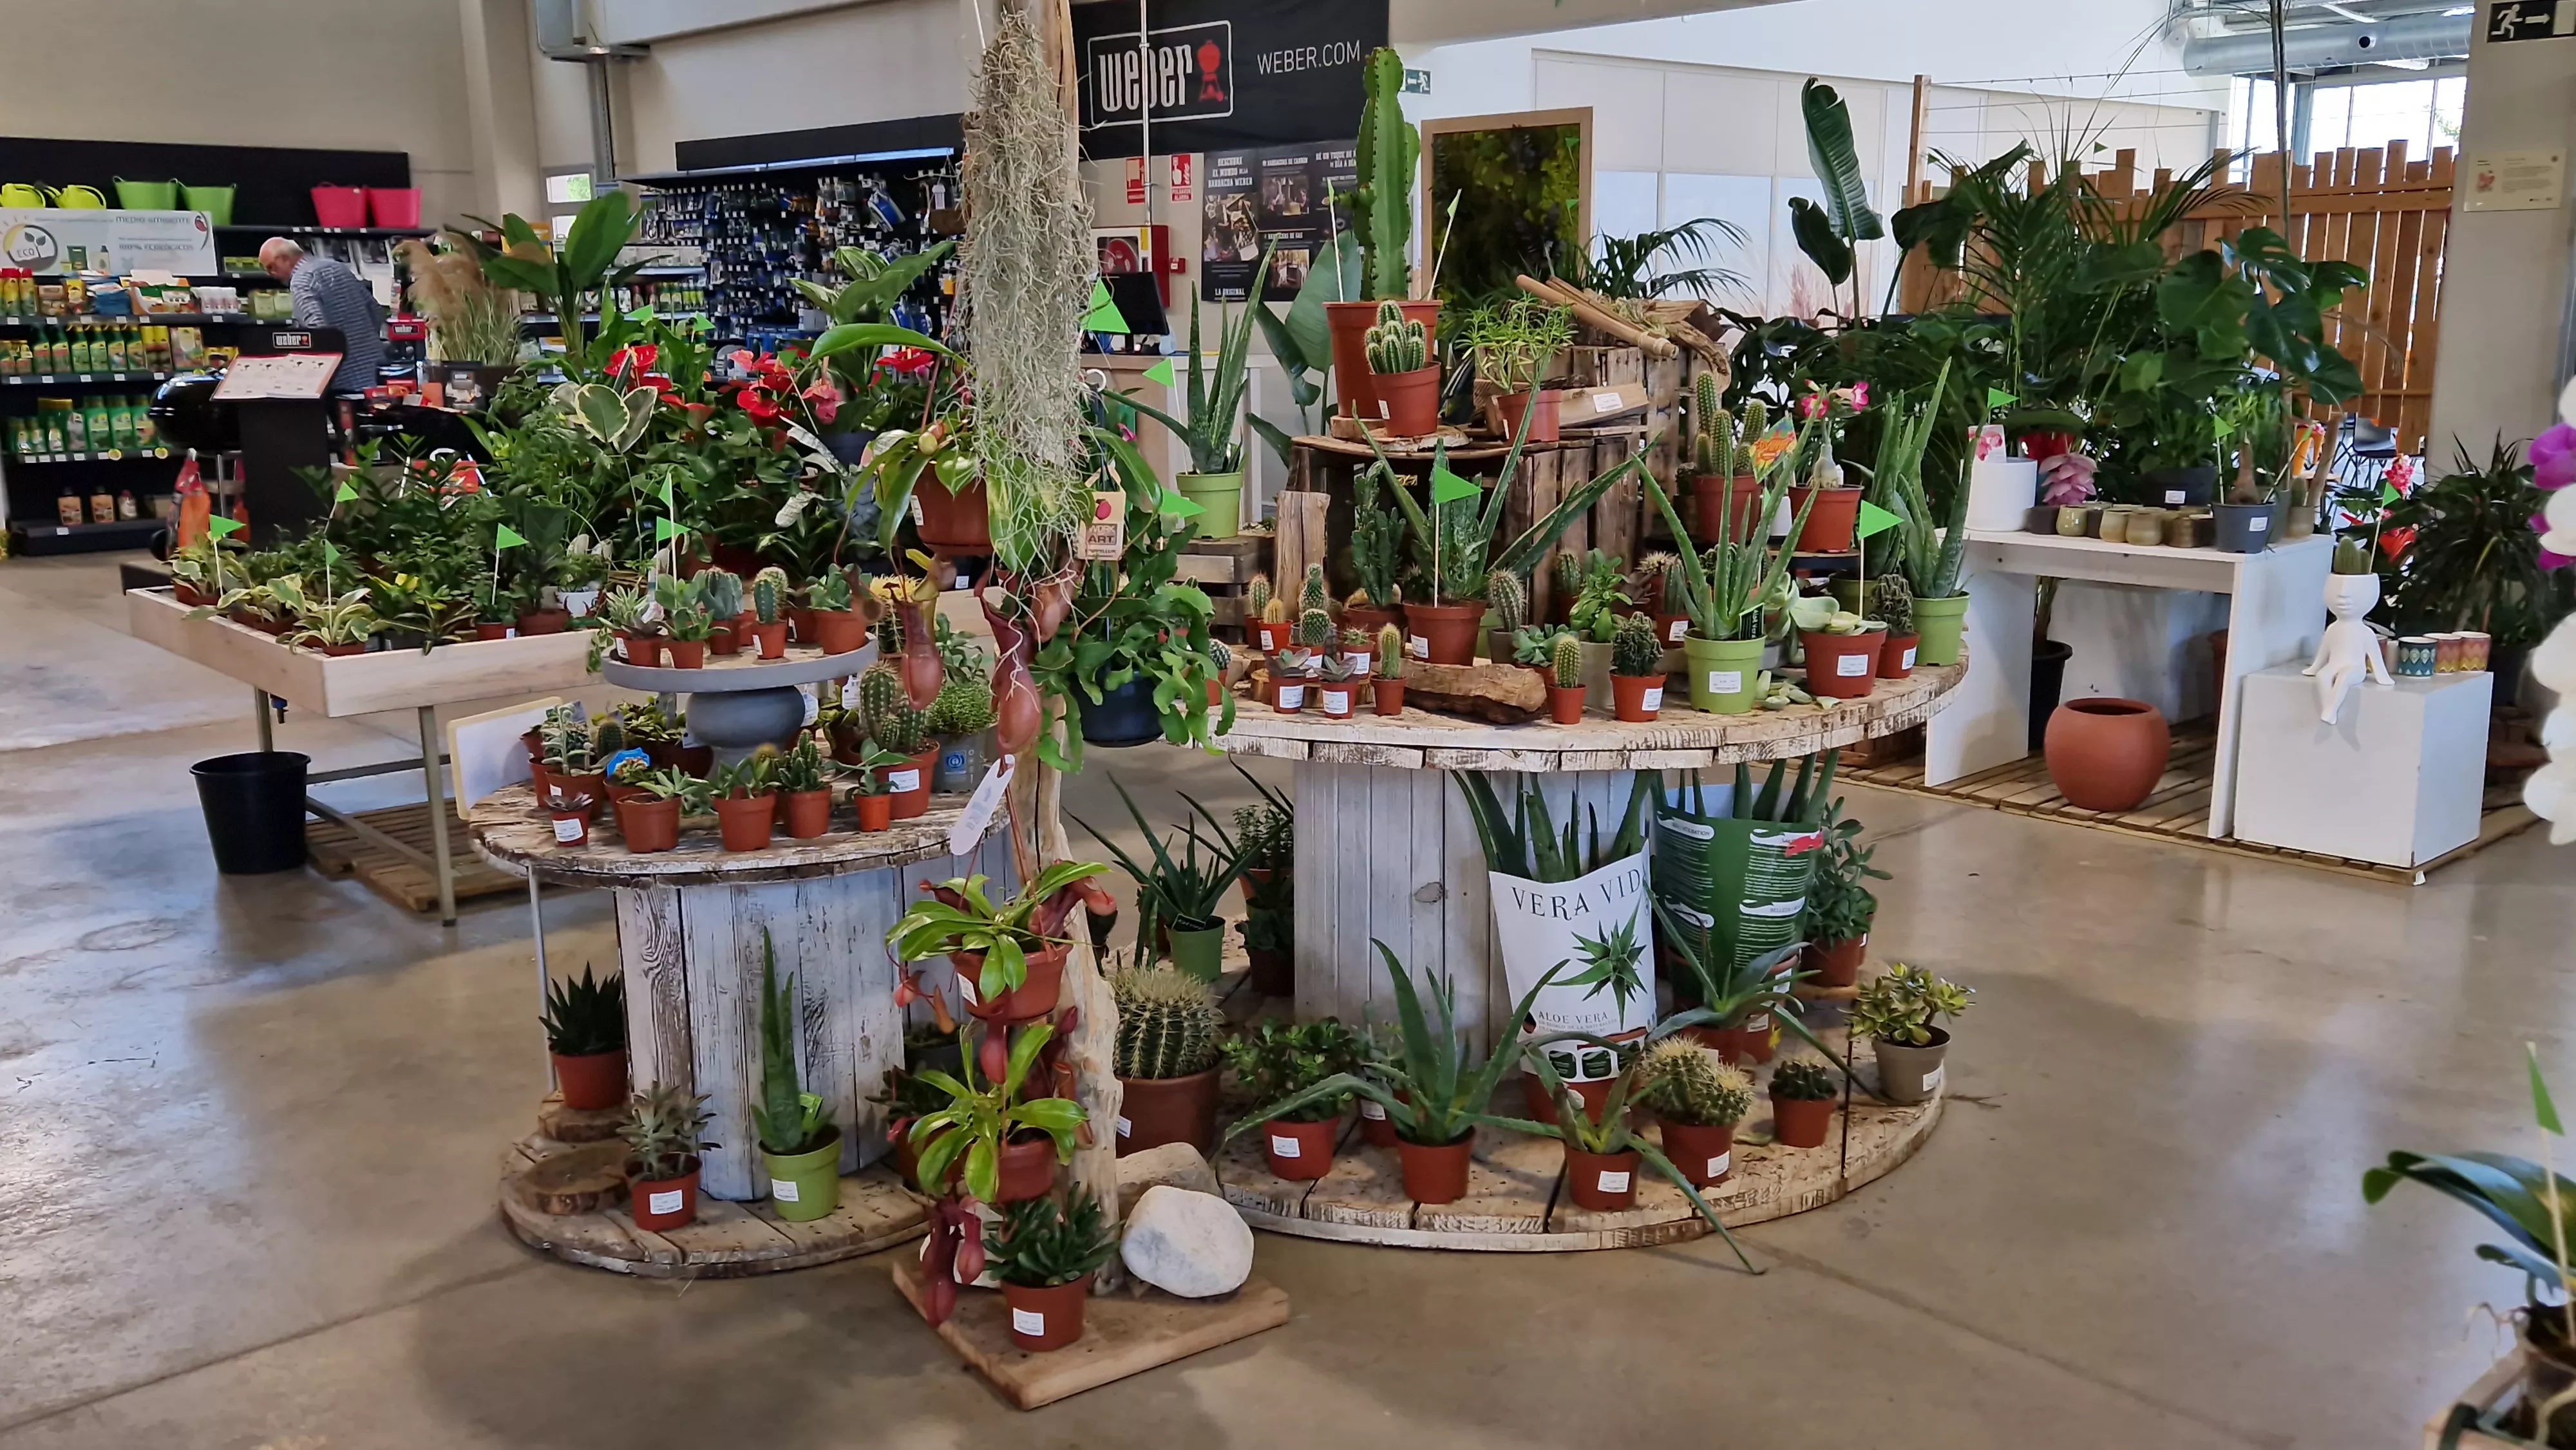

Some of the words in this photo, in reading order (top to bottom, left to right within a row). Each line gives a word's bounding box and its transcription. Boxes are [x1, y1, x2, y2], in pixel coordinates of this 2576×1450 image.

[1257, 40, 1361, 75] WEBER.COM
[1235, 177, 1253, 186] WEBER
[17, 248, 35, 258] ECO
[275, 332, 302, 346] weber
[1511, 885, 1591, 921] VERA
[1538, 1011, 1569, 1024] ALOE
[1575, 1012, 1609, 1024] VERA
